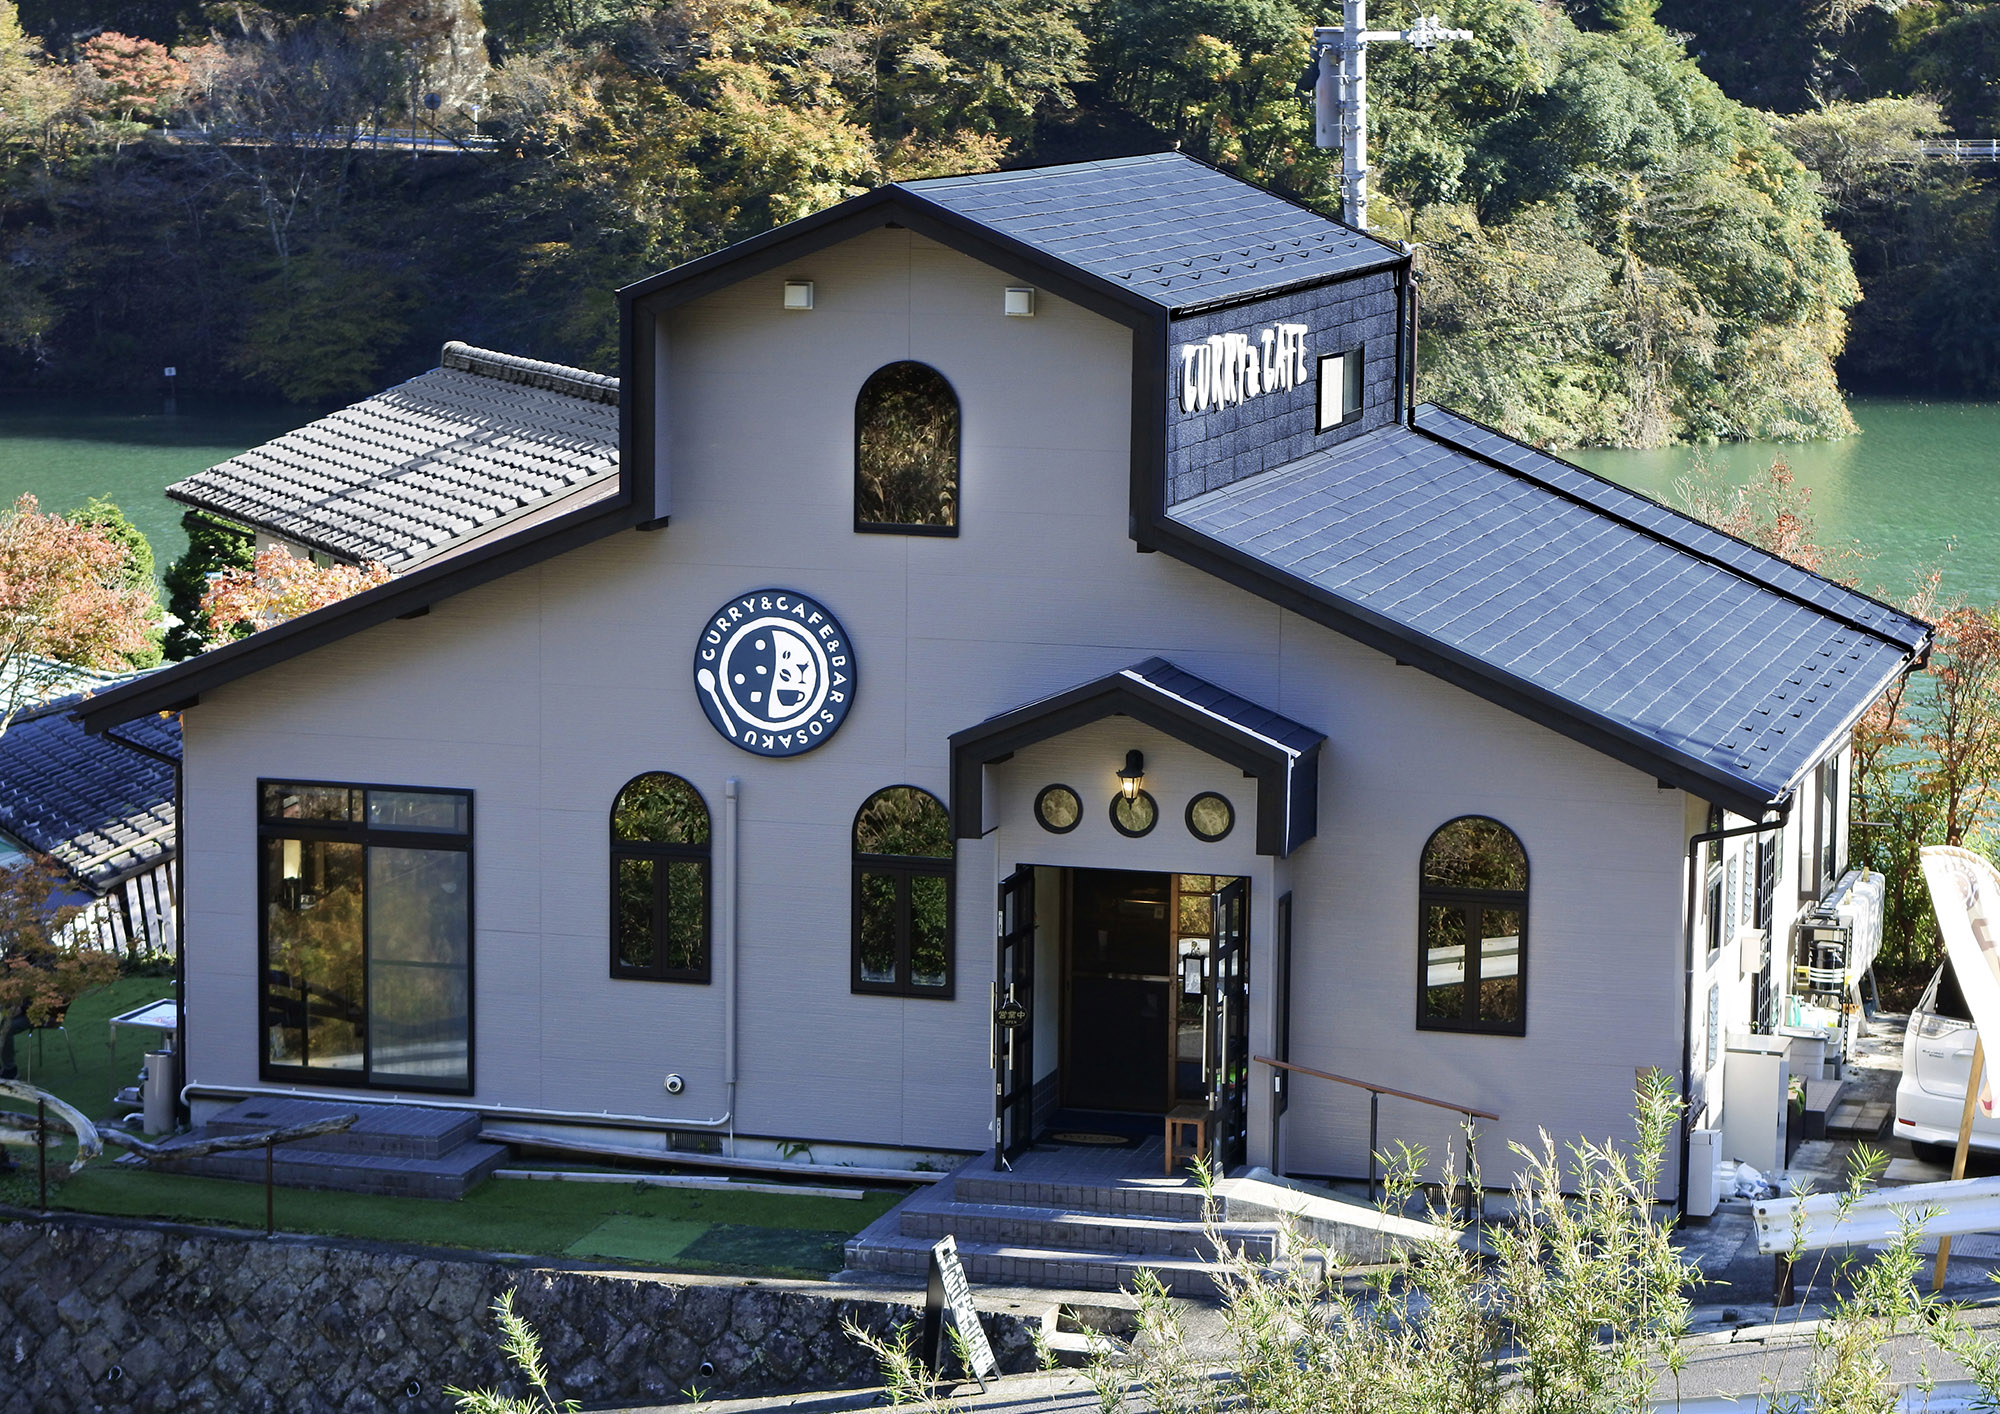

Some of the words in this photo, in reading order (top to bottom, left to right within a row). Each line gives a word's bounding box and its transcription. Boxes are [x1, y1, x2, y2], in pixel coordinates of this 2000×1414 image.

[744, 709, 834, 749] SOSAKU
[998, 1010, 1025, 1019] 営業中
